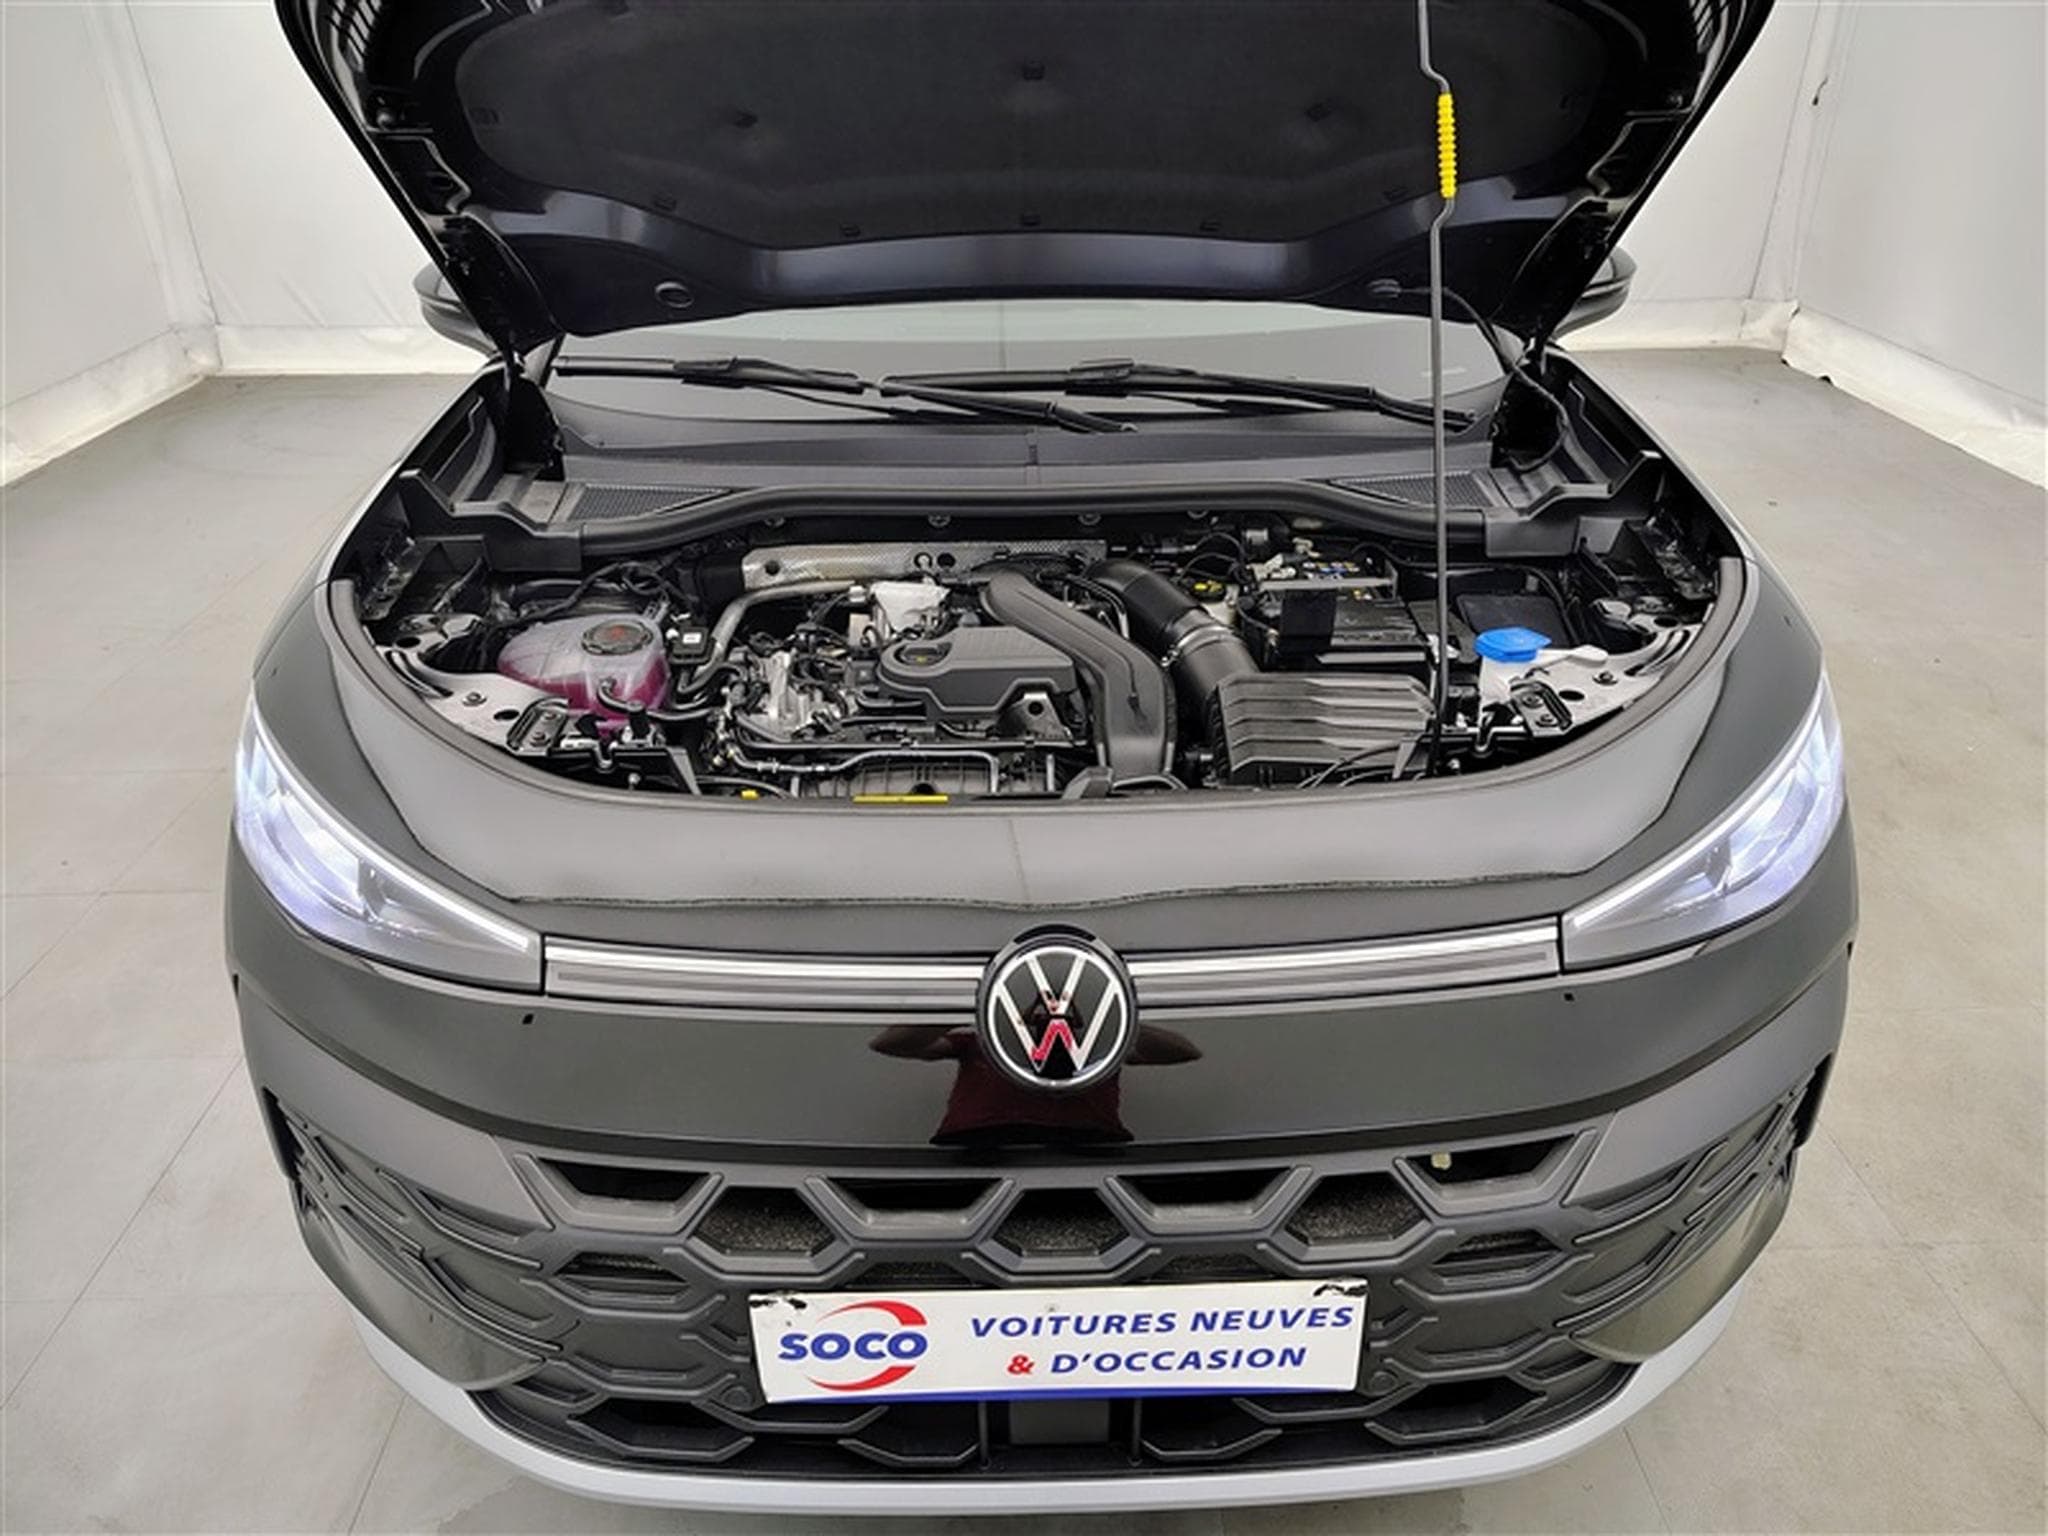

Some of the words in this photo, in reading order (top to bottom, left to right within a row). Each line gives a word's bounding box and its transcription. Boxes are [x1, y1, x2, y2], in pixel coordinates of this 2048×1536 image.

[972, 1313, 1176, 1338] VOITURES
[1190, 1307, 1354, 1332] NEUVES
[778, 1331, 929, 1361] SOCO
[1007, 1355, 1034, 1375] &
[1051, 1348, 1306, 1374] D'OCCASION
